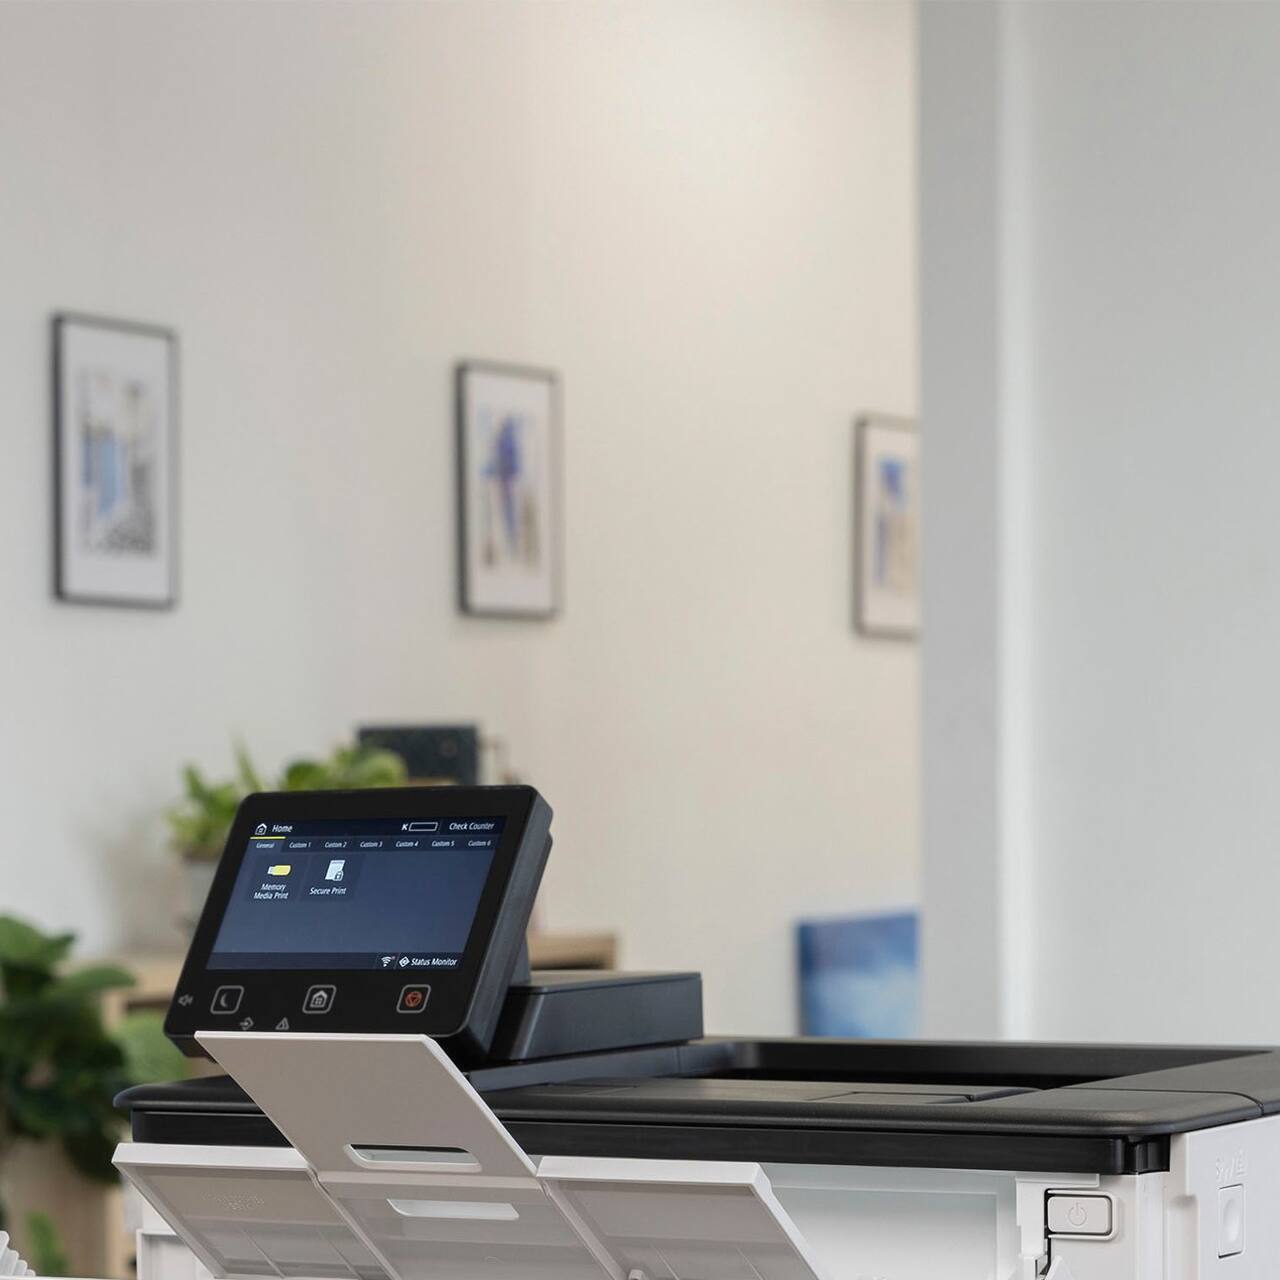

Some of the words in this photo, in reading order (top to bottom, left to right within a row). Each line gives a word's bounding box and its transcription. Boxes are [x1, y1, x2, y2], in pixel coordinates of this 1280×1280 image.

[272, 824, 293, 833] Home
[401, 823, 408, 831] K
[449, 823, 468, 831] Check
[469, 823, 495, 831] Counter
[261, 883, 286, 892] Memory
[310, 887, 330, 895] Secure
[331, 886, 346, 894] Print
[274, 891, 288, 899] Print
[411, 958, 430, 966] Status
[431, 958, 457, 966] Monitor
